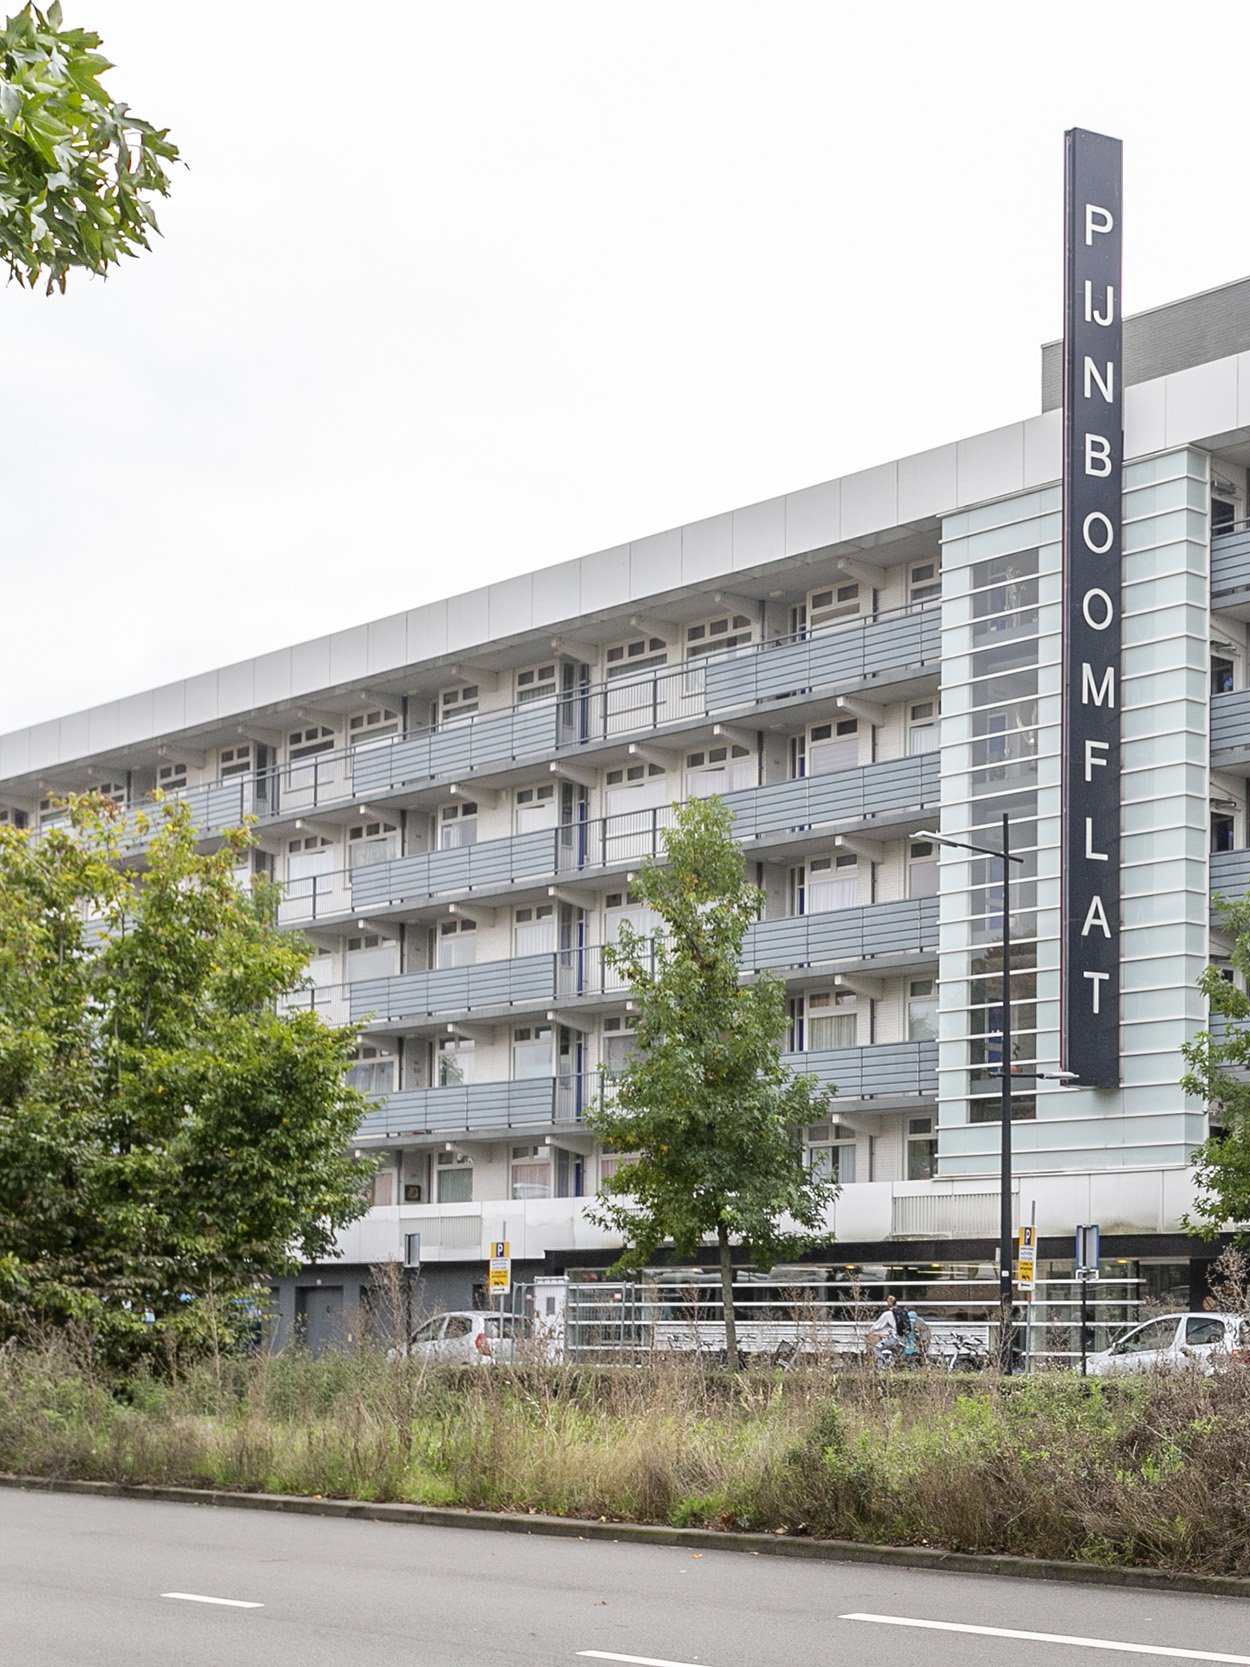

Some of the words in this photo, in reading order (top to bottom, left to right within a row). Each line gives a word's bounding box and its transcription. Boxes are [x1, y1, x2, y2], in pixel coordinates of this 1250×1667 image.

[1082, 203, 1115, 1014] PIJNBOOMFLAT
[1025, 1229, 1031, 1244] P
[497, 1244, 503, 1257] P
